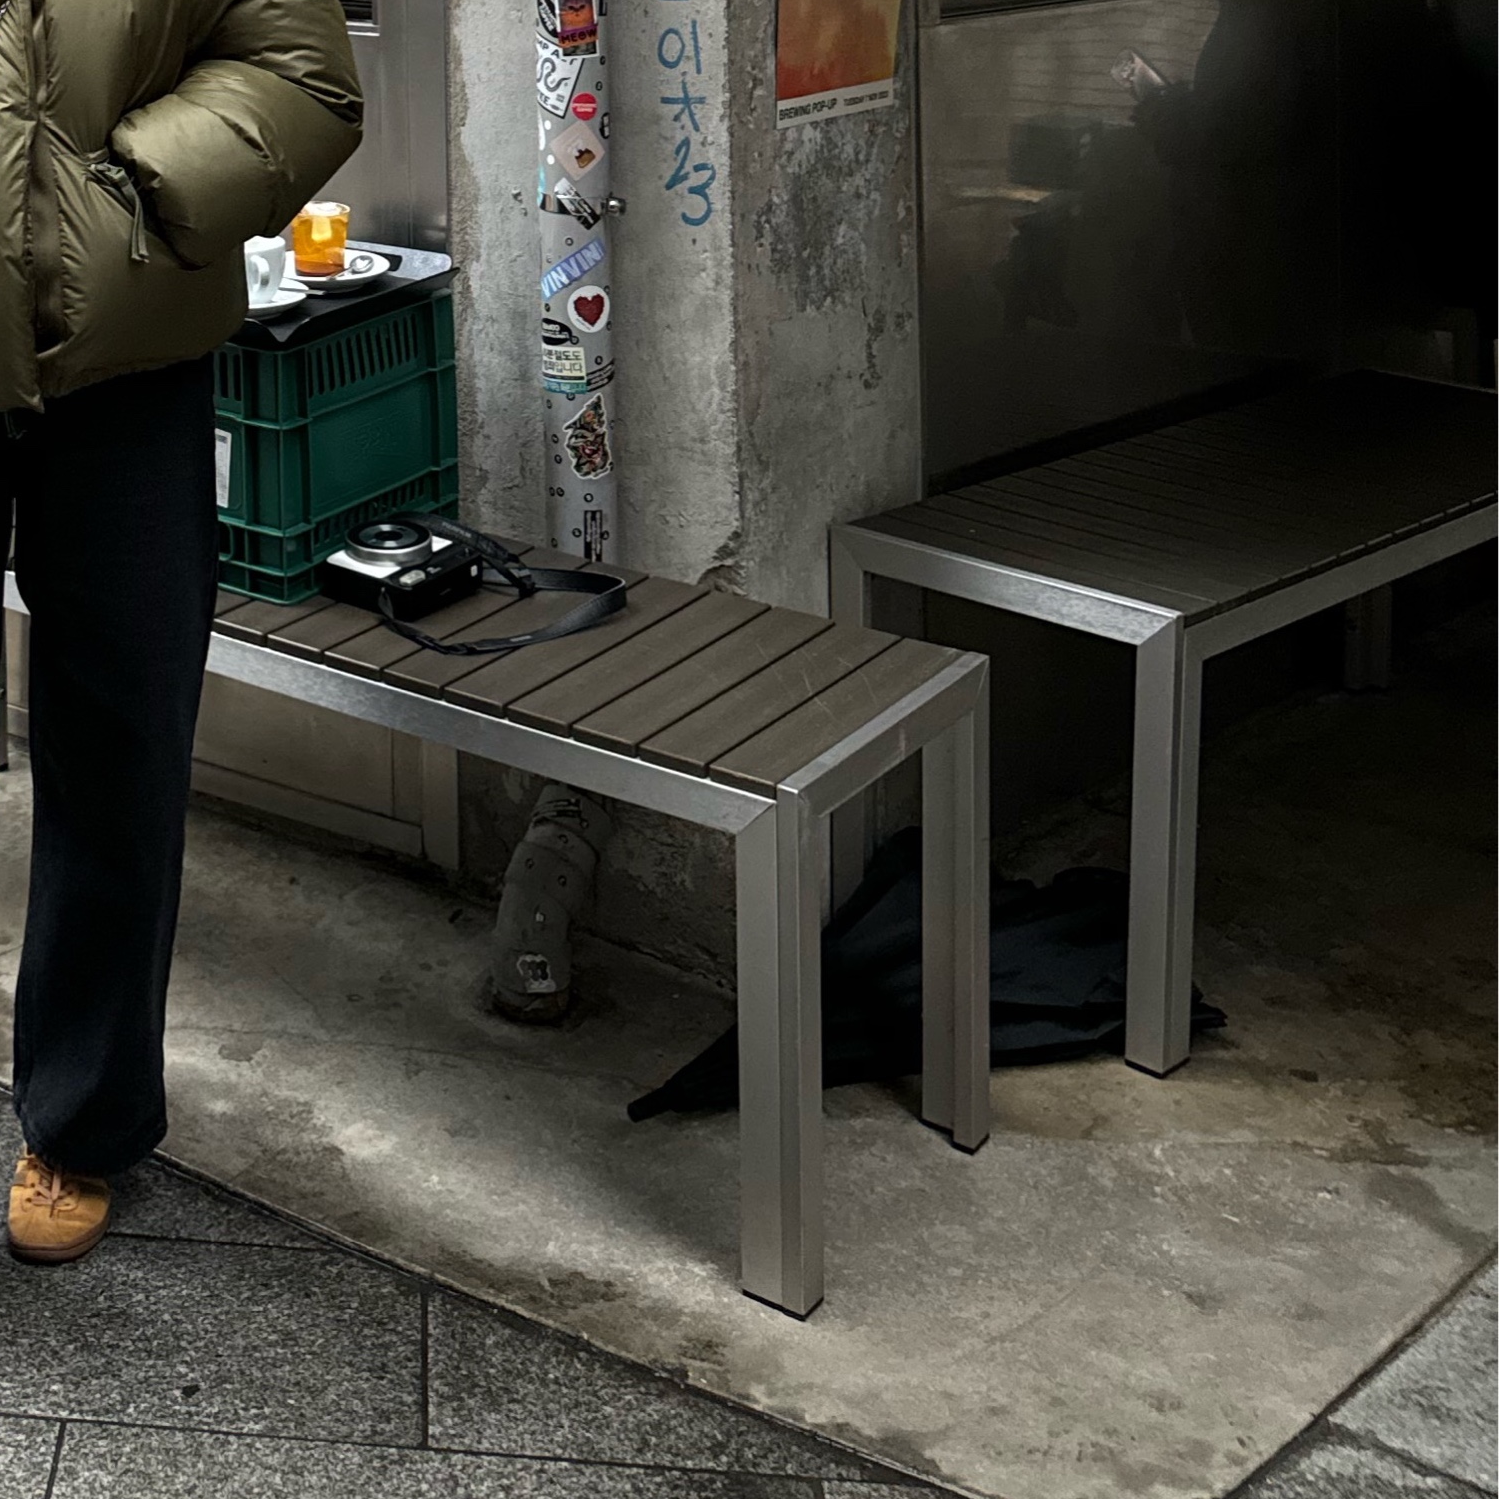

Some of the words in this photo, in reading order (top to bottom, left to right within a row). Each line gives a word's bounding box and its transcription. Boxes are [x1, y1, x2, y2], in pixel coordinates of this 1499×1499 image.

[560, 29, 596, 45] MEOW
[779, 103, 811, 120] BREWING
[812, 98, 837, 113] POP-UP
